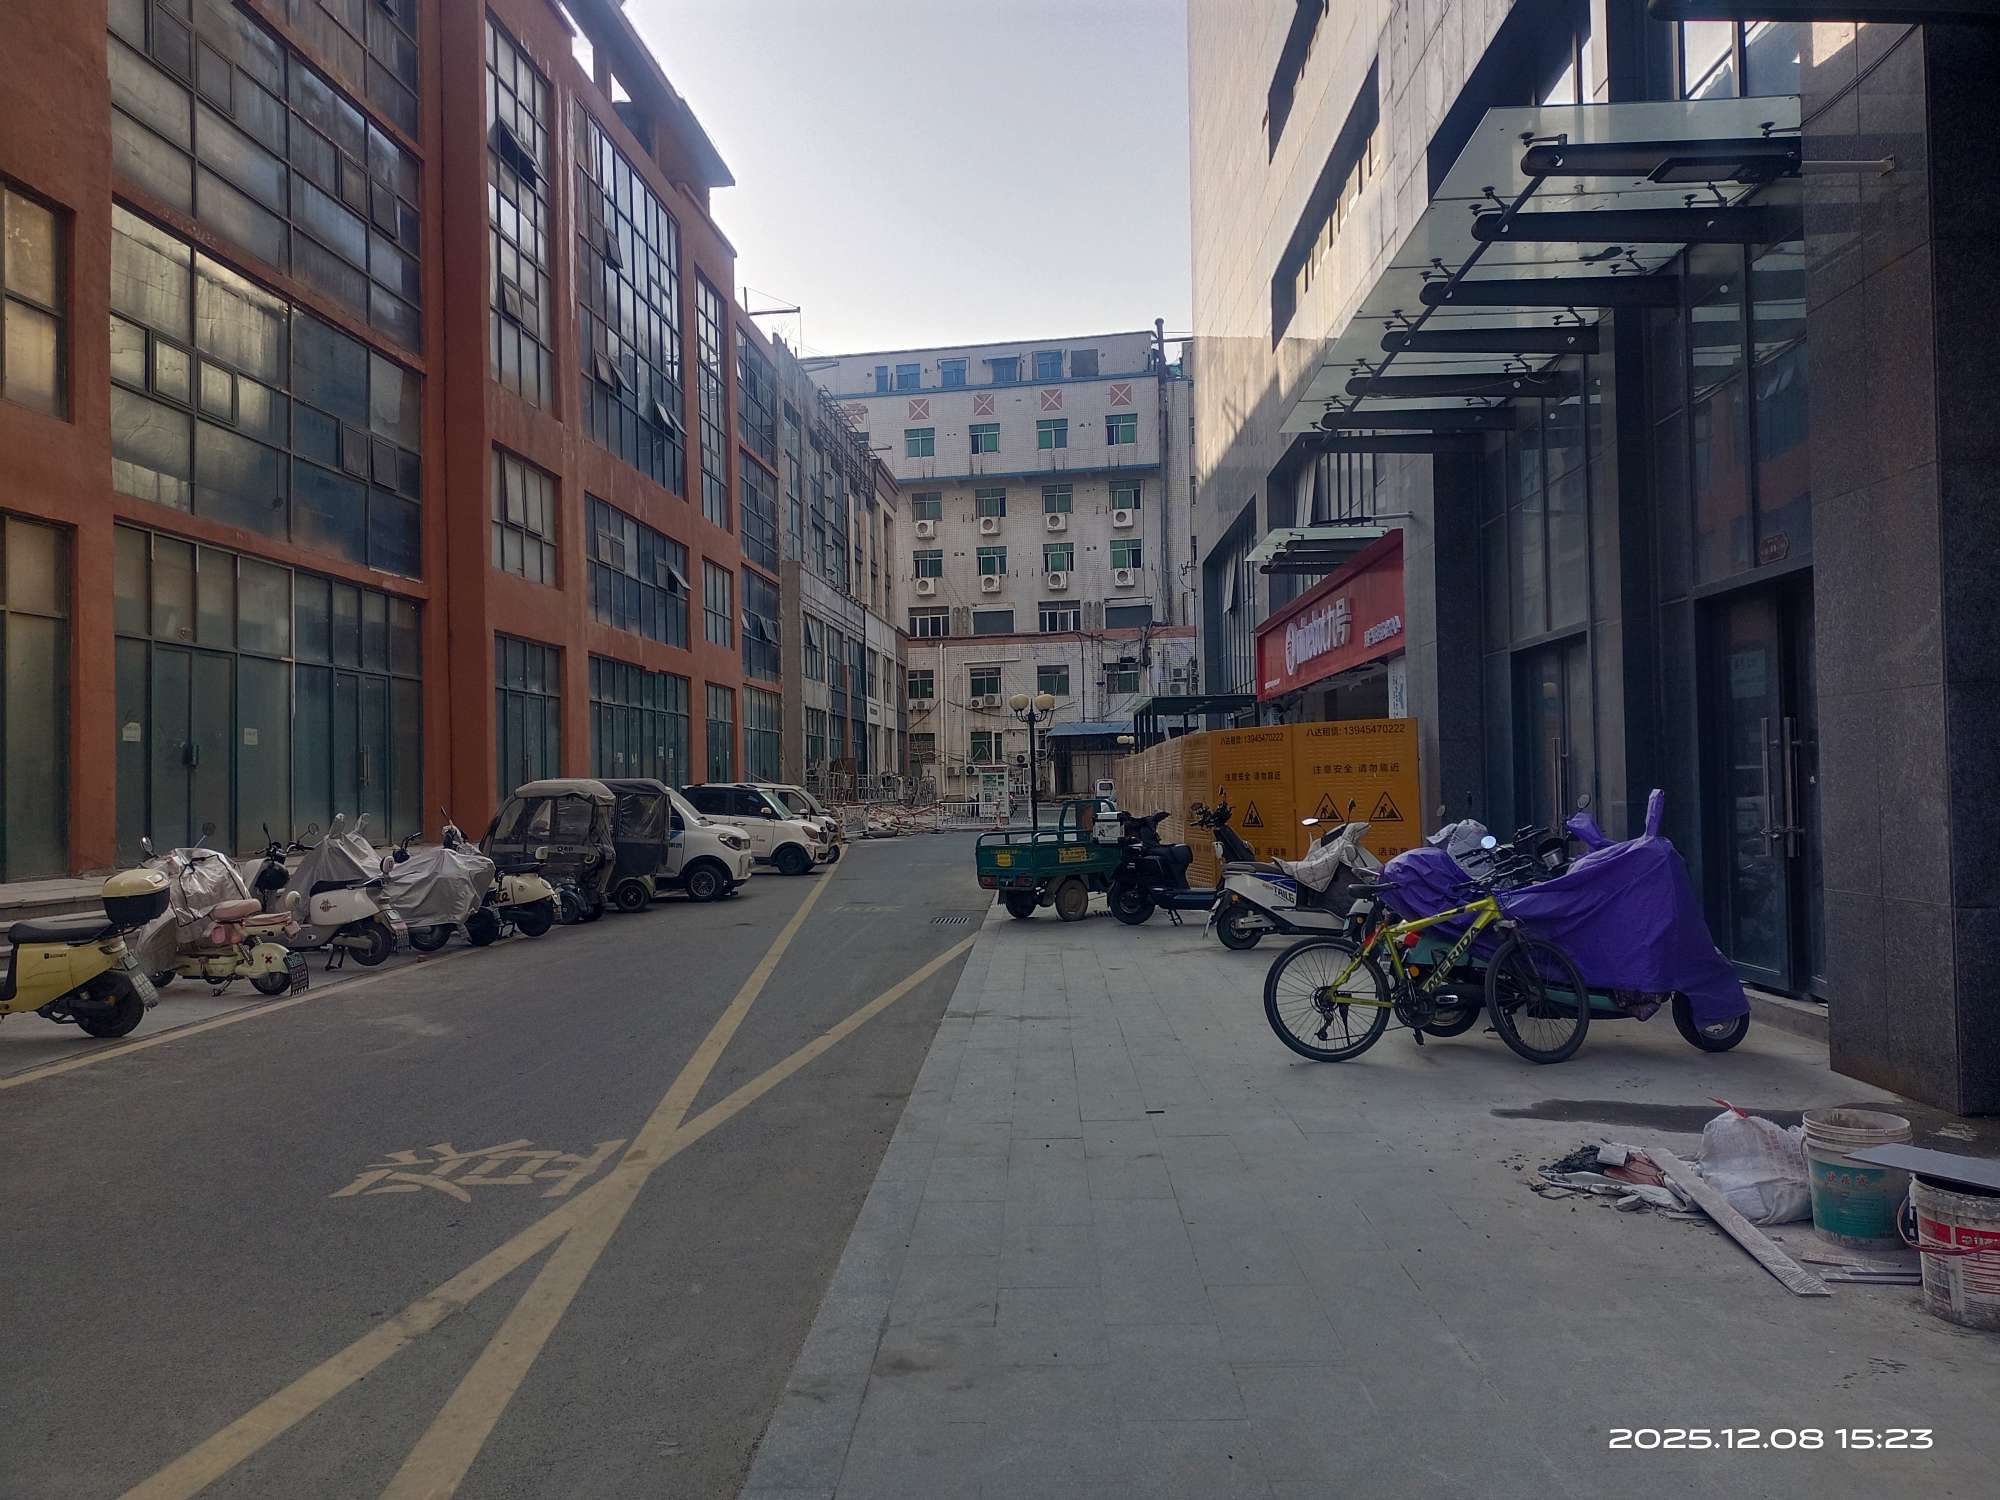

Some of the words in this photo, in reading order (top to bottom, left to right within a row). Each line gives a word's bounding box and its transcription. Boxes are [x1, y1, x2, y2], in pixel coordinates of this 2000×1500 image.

[1344, 723, 1406, 736] 13945470222
[1273, 885, 1295, 904] TAILG
[1423, 926, 1480, 992] MERIDA
